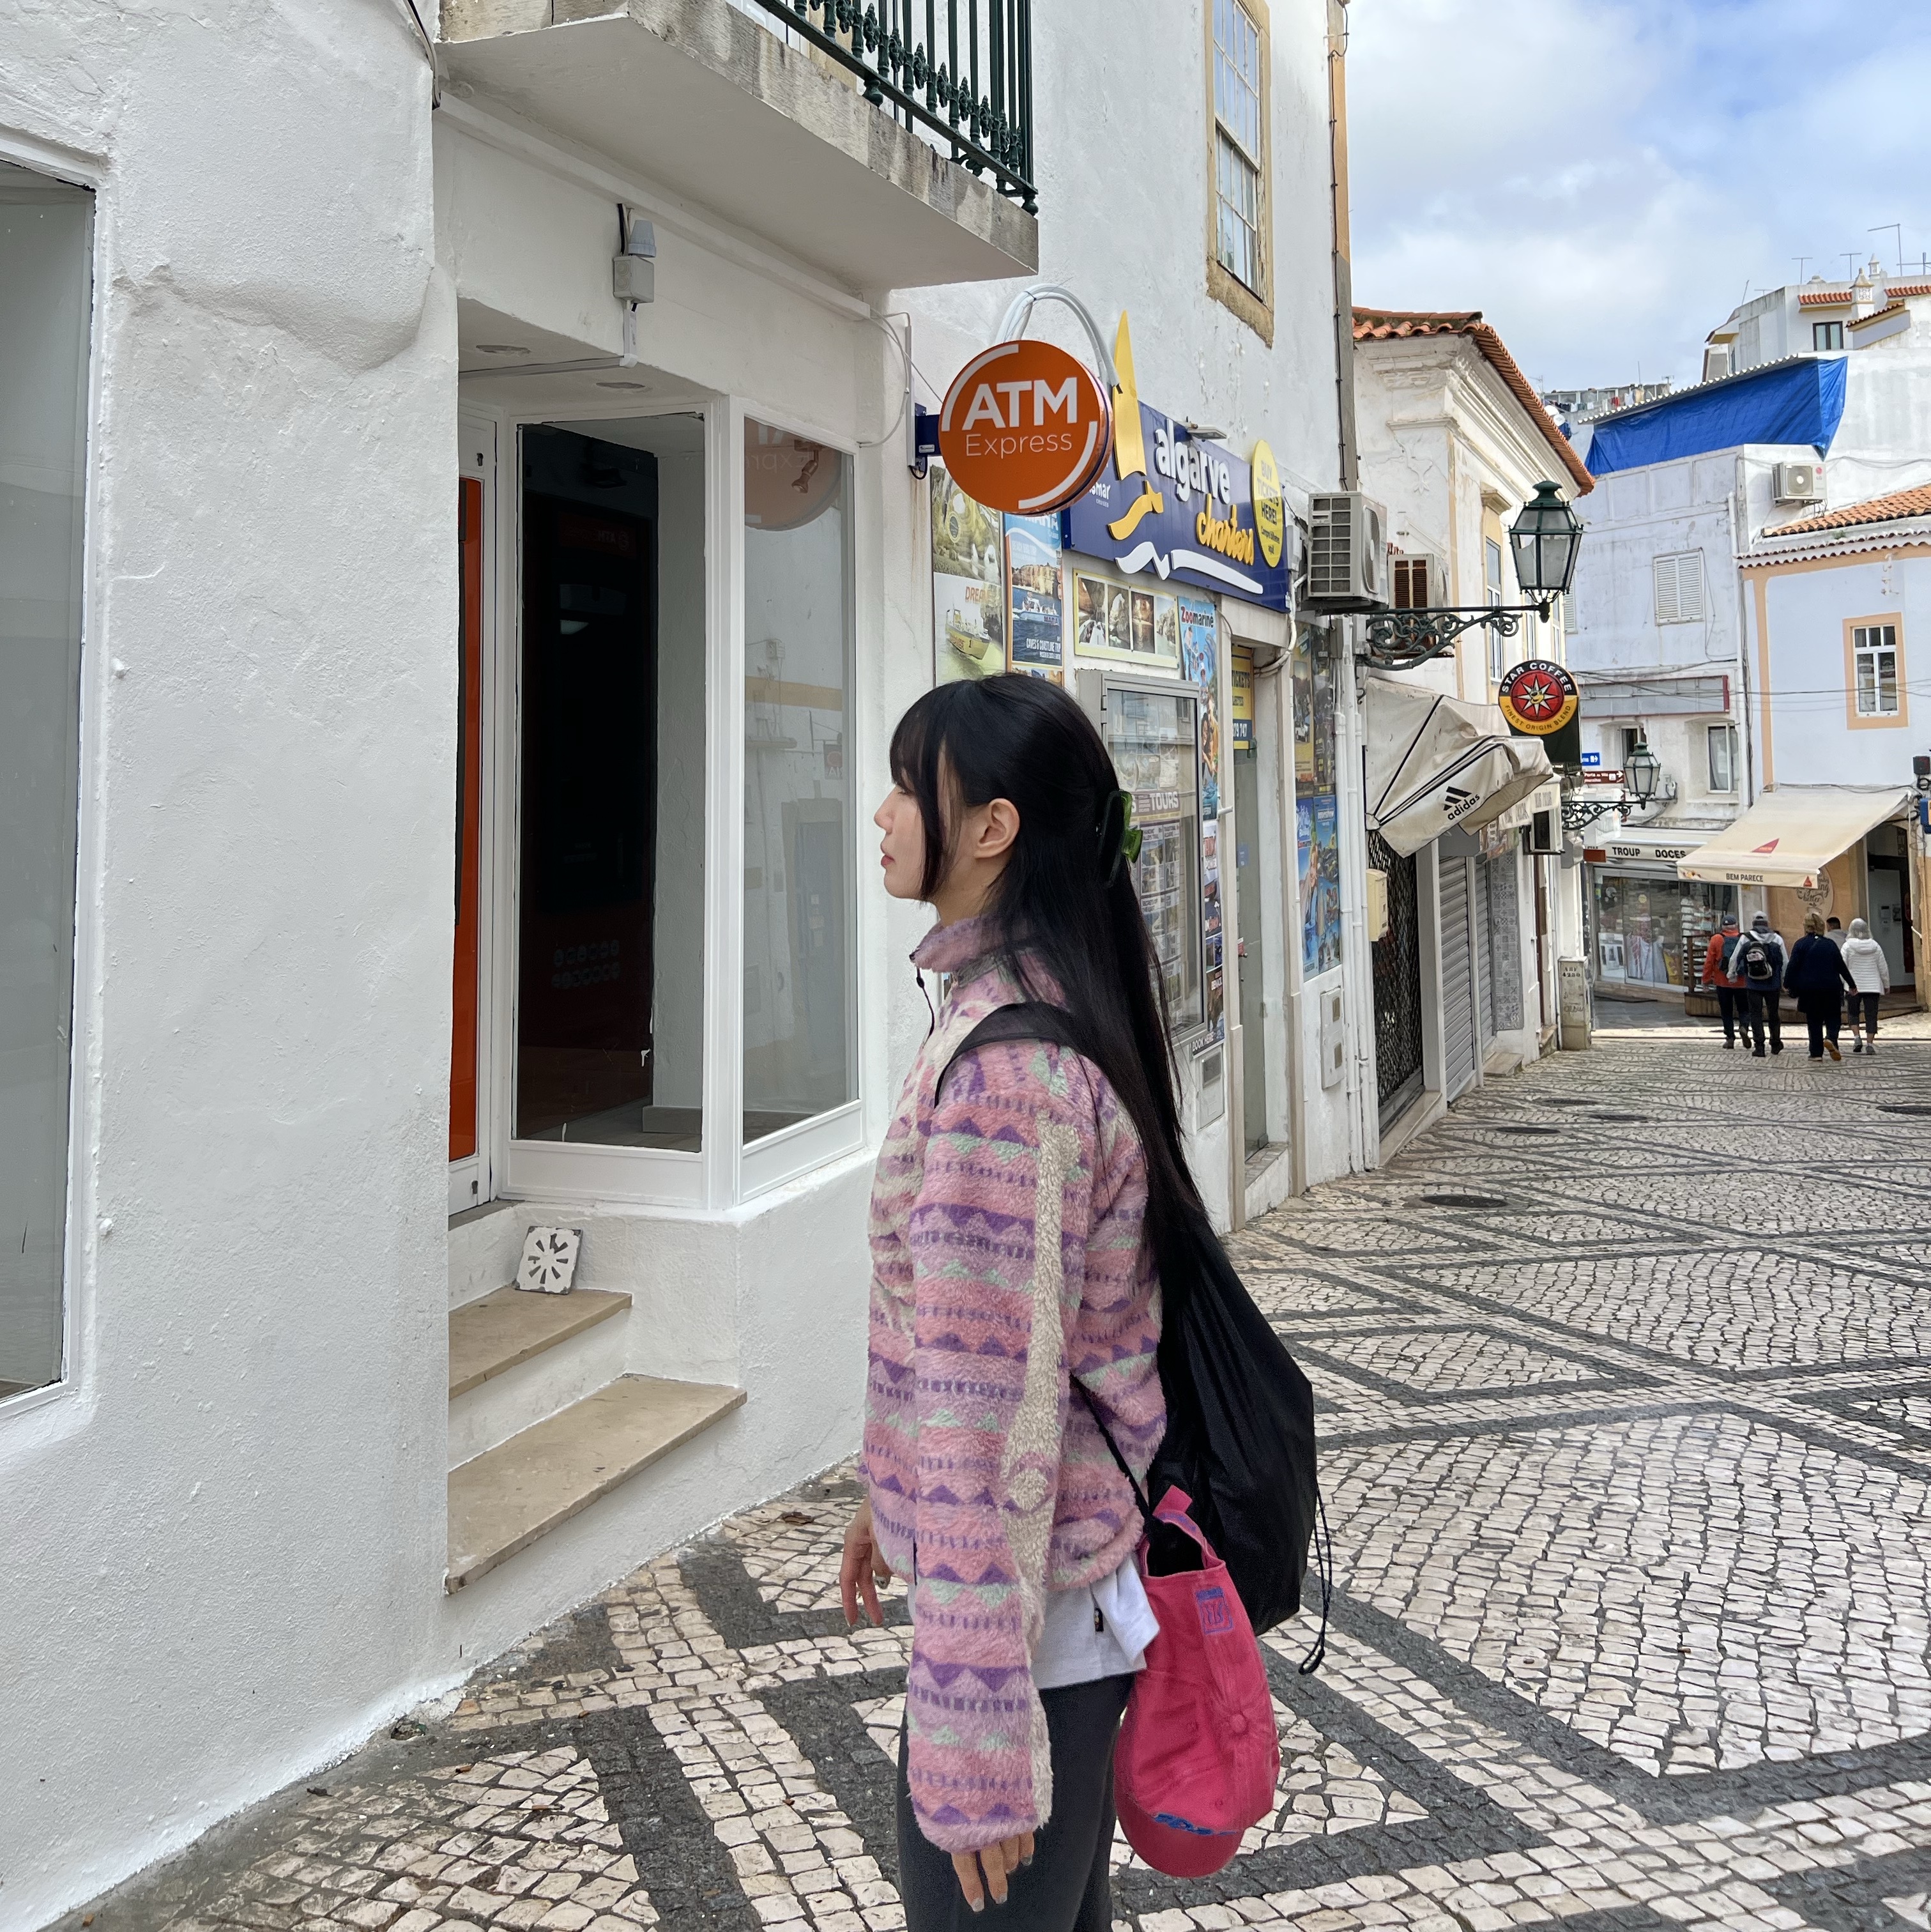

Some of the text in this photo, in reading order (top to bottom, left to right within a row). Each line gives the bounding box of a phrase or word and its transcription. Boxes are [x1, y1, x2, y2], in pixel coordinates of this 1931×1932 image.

[961, 377, 1077, 431] ATM
[966, 433, 1072, 459] Express
[1154, 418, 1230, 505] algarve
[1261, 460, 1272, 482] BUY
[1256, 477, 1279, 507] TICKETS
[1261, 500, 1278, 526] HERE!
[1196, 493, 1255, 566] charters
[1181, 606, 1214, 628] Zoomarine
[1502, 663, 1572, 693] STAR COFFEE
[1505, 705, 1524, 726] FINEST
[1553, 705, 1571, 726] BLEND
[1150, 791, 1179, 811] TOURS
[1447, 793, 1480, 820] adidas
[1612, 847, 1686, 859] TROUP DOCES
[1726, 873, 1764, 882] BEM PARECE
[1191, 1037, 1205, 1052] BOOK
